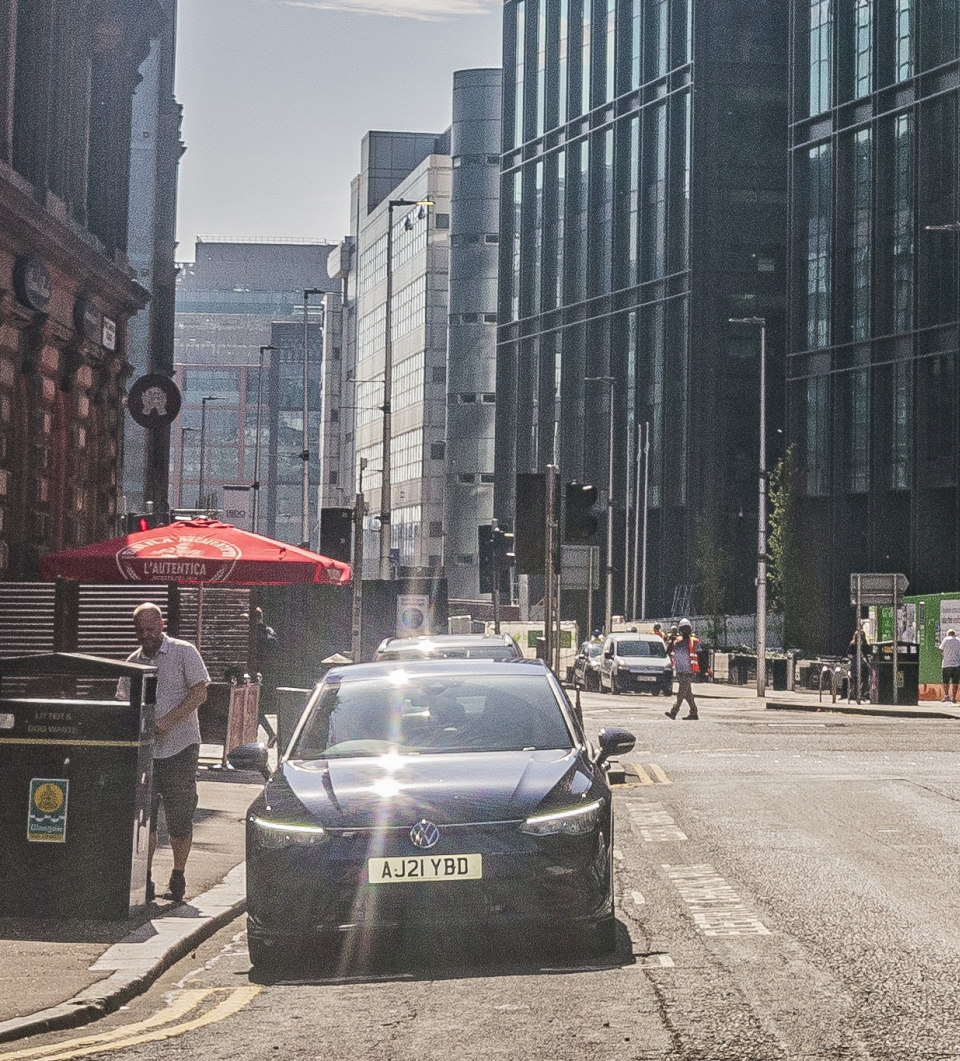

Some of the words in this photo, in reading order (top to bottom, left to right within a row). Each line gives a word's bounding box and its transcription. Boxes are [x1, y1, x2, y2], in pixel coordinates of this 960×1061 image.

[143, 561, 207, 576] L'AUTENTICA
[381, 859, 424, 879] AJ21
[431, 857, 468, 876] YBD
